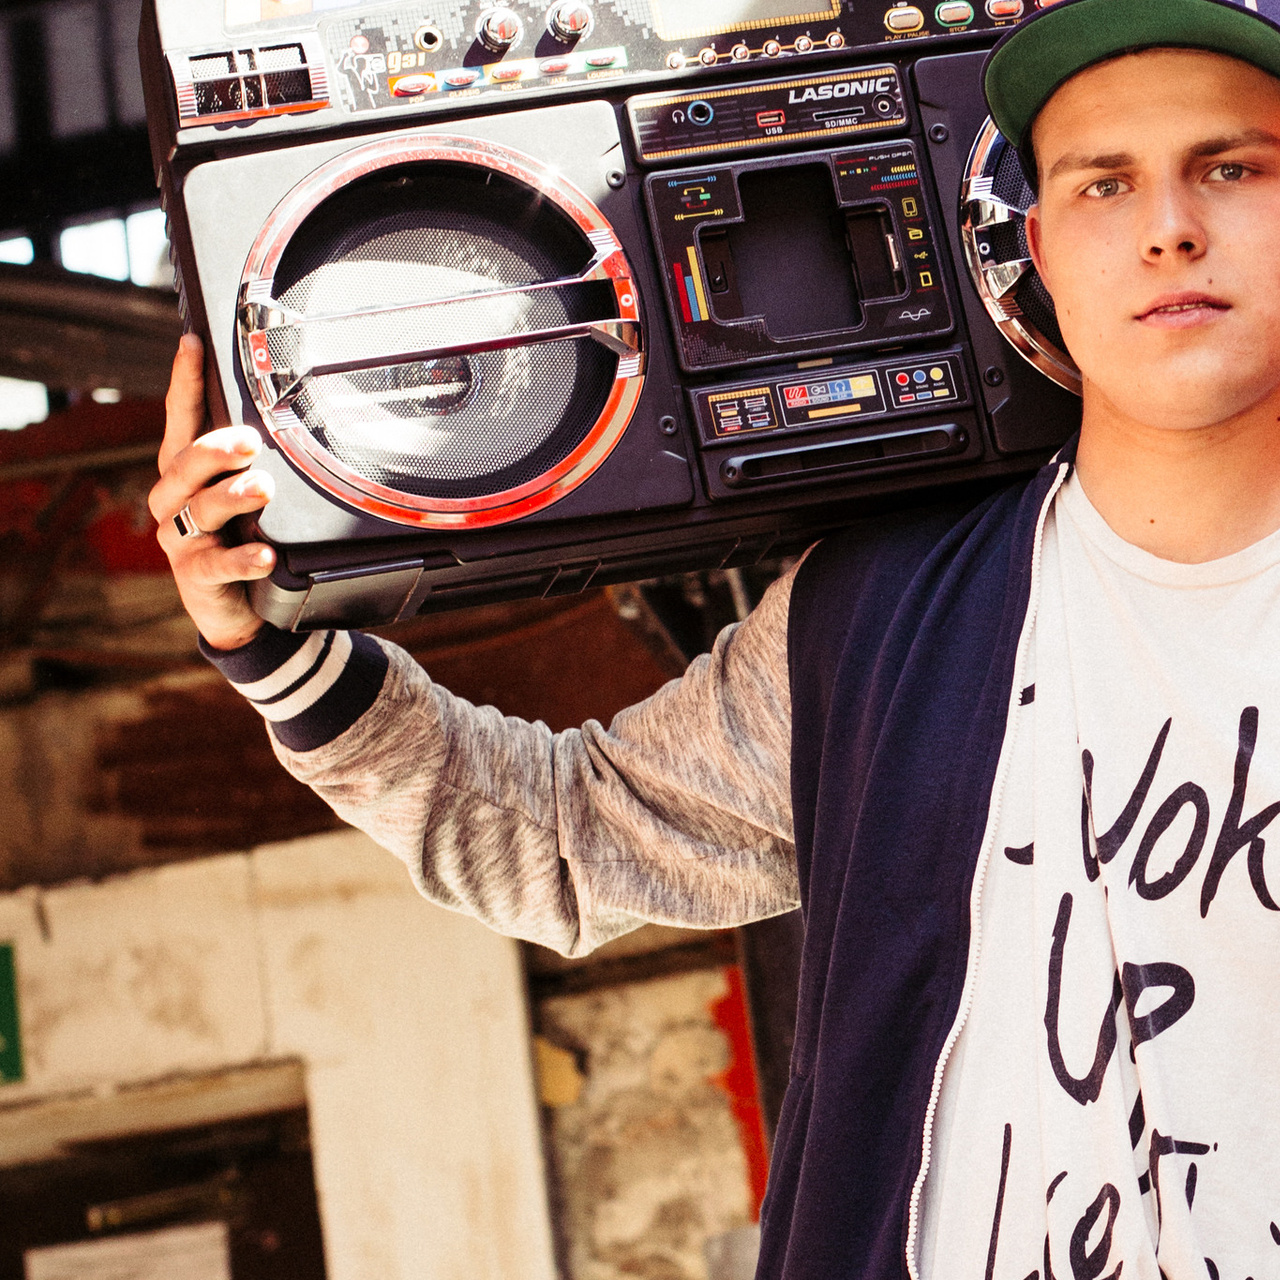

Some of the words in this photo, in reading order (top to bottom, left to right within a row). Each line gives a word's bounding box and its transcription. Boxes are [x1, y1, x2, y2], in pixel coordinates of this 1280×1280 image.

[949, 25, 967, 33] STOP
[885, 33, 902, 41] PLAY
[907, 30, 930, 38] PAUSE
[550, 76, 568, 85] JAZZ
[501, 83, 523, 92] ROCK
[409, 95, 425, 104] POP
[825, 117, 859, 129] SD/MMC
[765, 126, 783, 135] USB
[892, 150, 913, 159] OPEN
